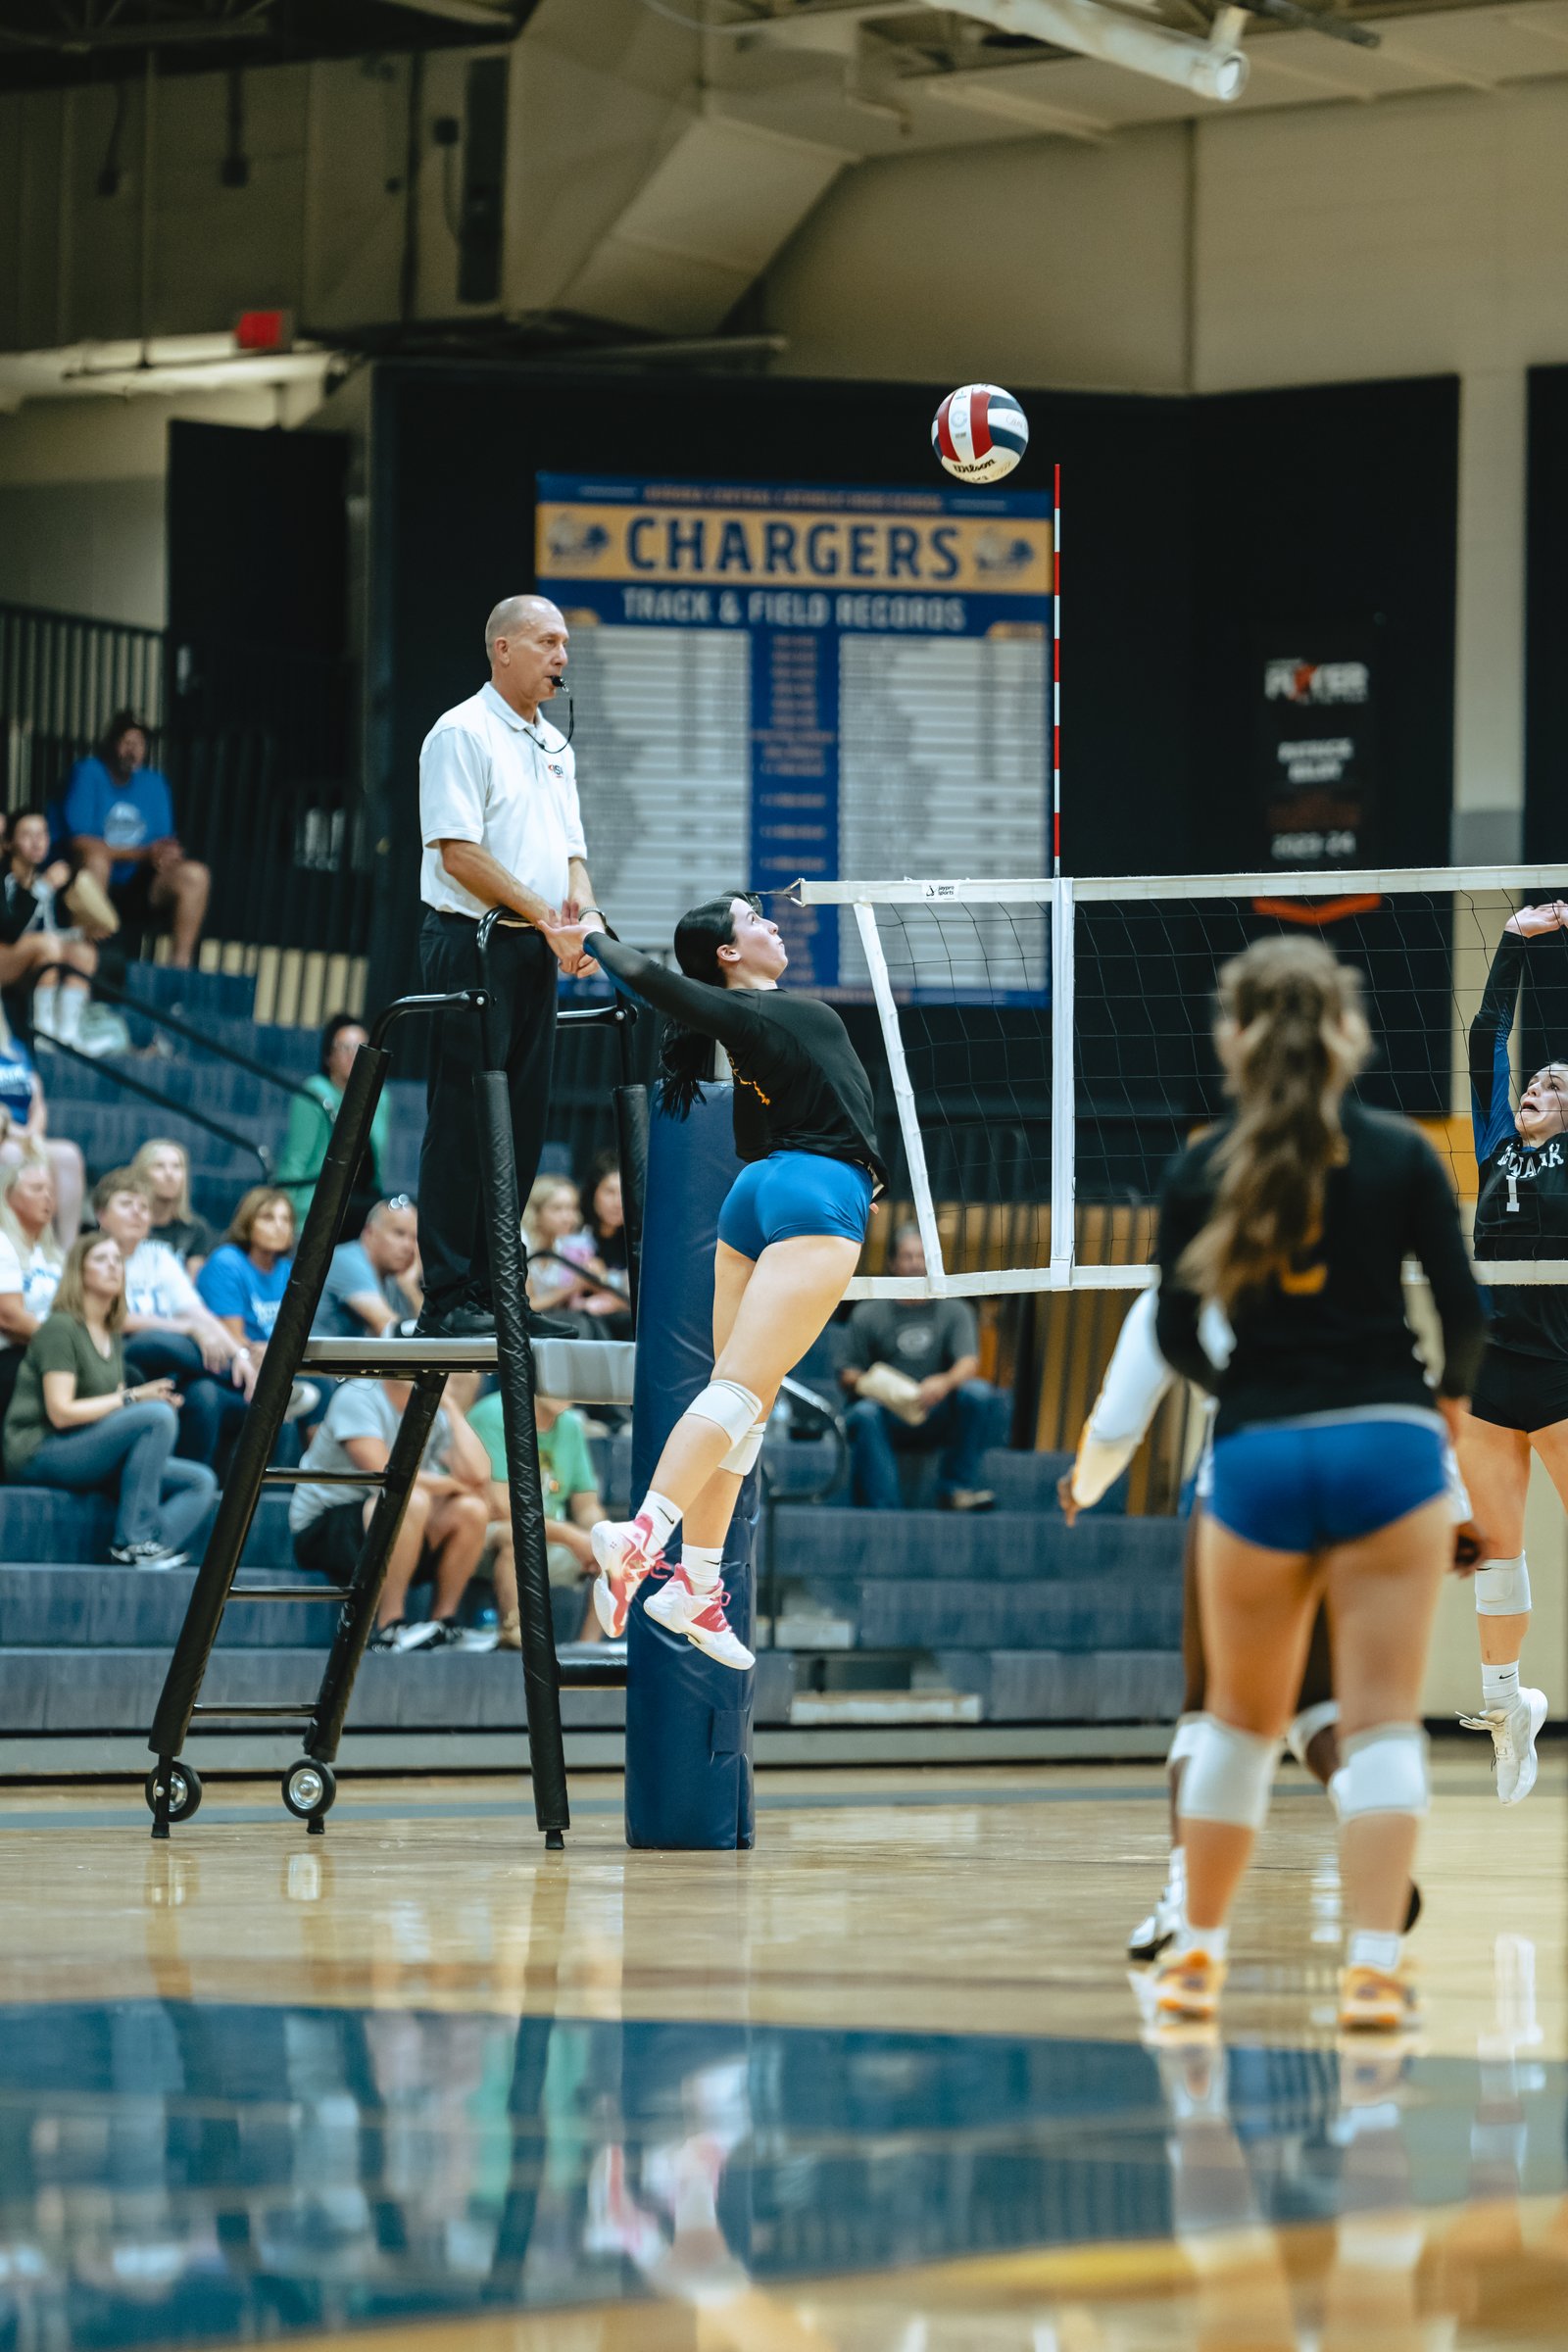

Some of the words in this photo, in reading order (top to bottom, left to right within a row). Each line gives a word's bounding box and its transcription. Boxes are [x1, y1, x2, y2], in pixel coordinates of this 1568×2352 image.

[953, 459, 996, 472] Wilson
[624, 515, 961, 580] CHARGERS
[623, 588, 711, 622] TRACK
[718, 592, 742, 624] &
[748, 591, 829, 626] FIELD
[837, 594, 967, 631] RECORDS
[1505, 1174, 1520, 1212] 1
